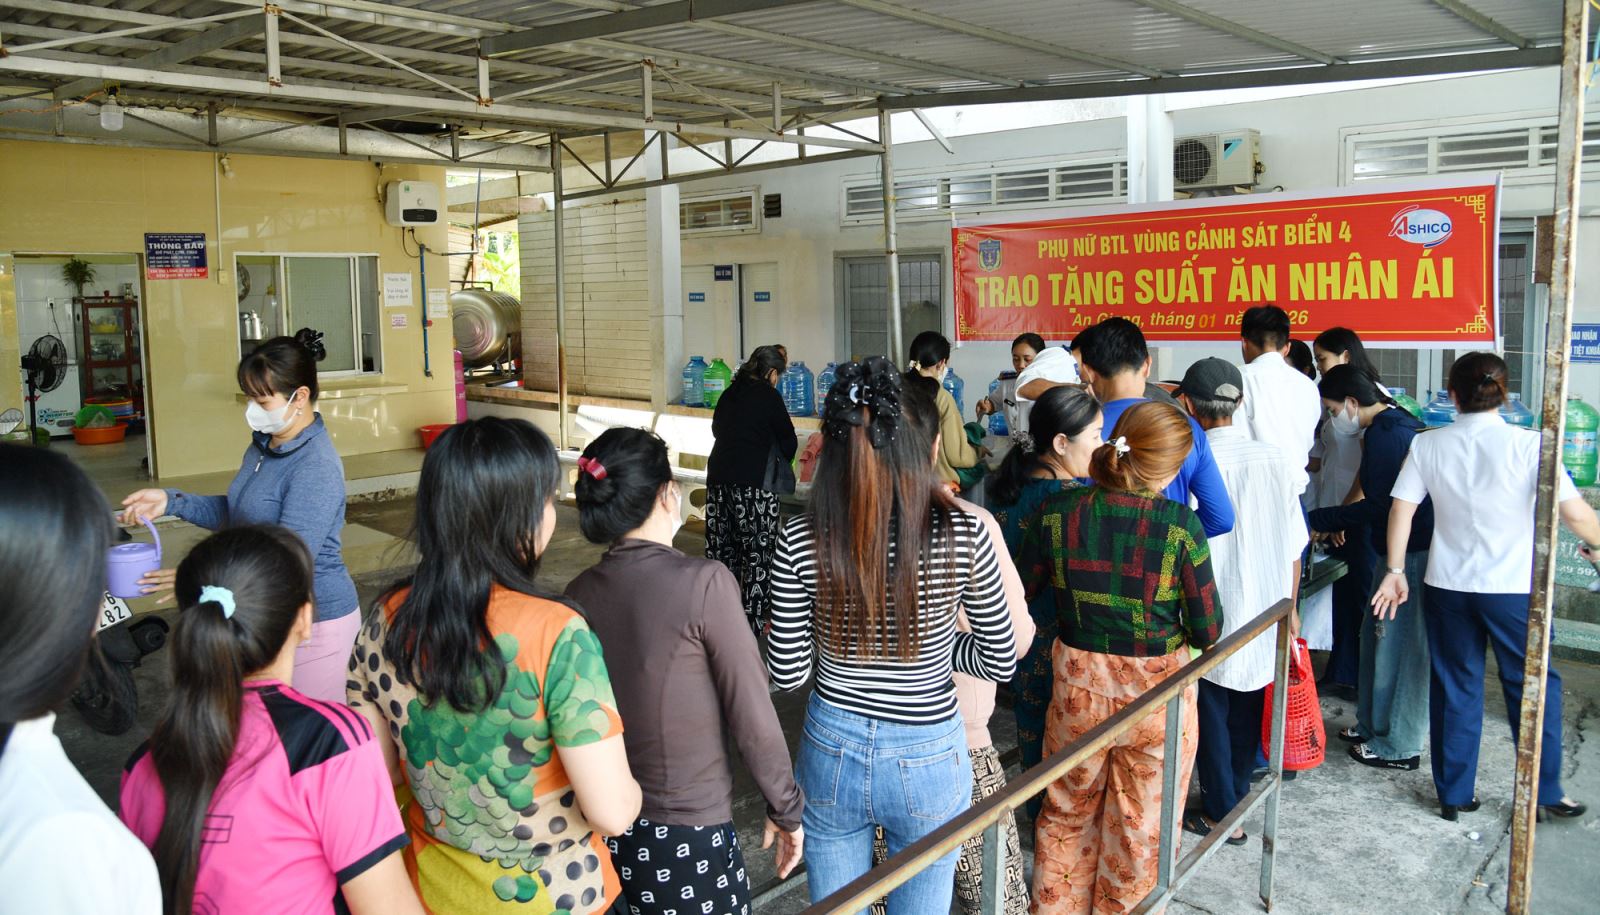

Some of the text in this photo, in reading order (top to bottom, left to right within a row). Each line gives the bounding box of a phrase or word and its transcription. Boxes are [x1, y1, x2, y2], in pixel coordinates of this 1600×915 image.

[1388, 216, 1452, 236] ASHICO
[149, 241, 181, 249] THÔNG
[1038, 213, 1352, 262] PHỤ NỮ BTL VÙNG CẢNH SÁT BIỂN 4
[975, 248, 1454, 314] TRAO TẶNG SUẤT ĂN NHÂN ÁI
[1072, 312, 1092, 327] An
[1150, 312, 1195, 329] tháng
[1199, 313, 1217, 329] 01
[1224, 310, 1244, 325] nă
